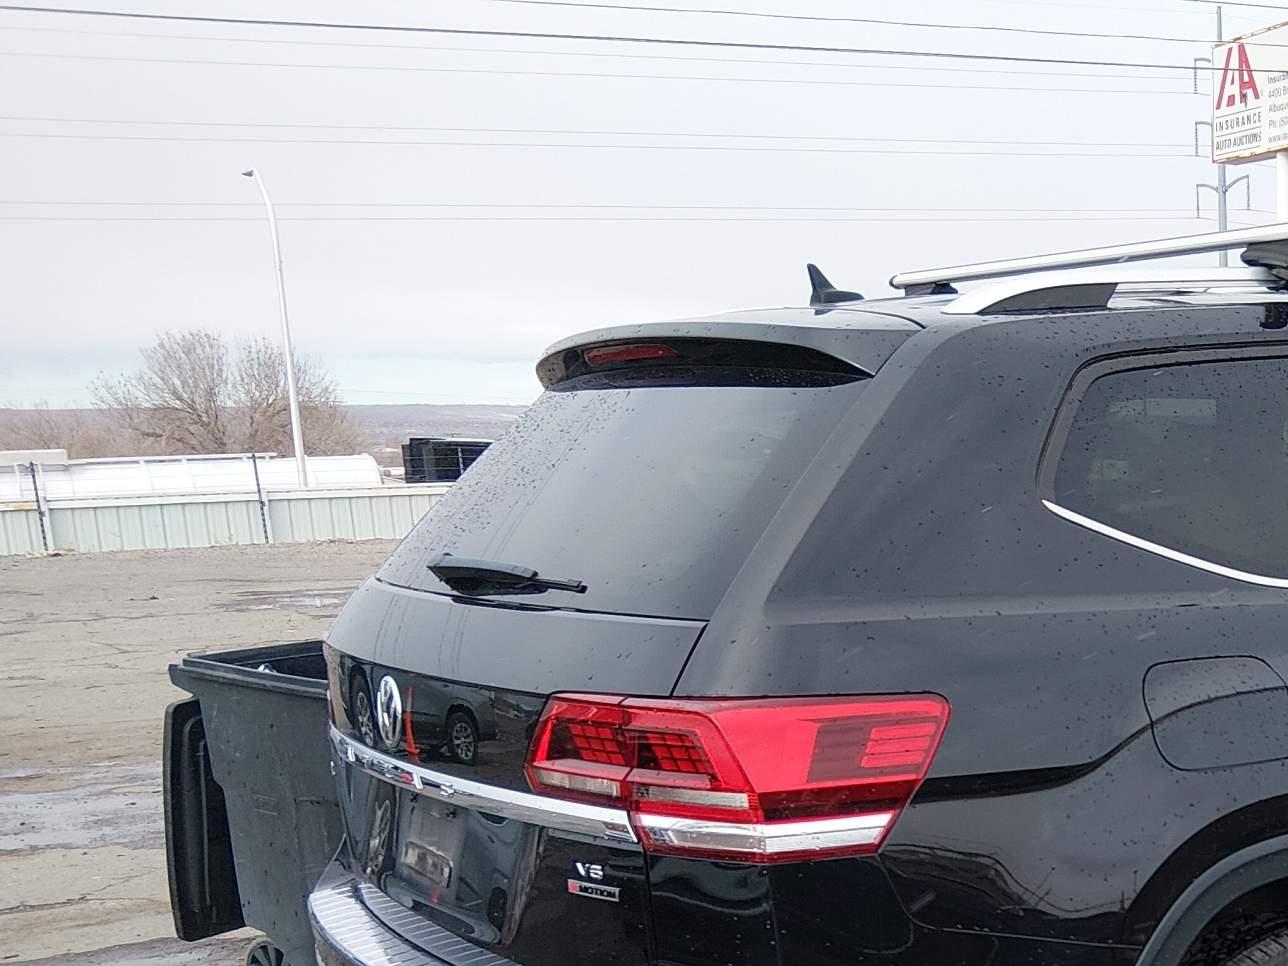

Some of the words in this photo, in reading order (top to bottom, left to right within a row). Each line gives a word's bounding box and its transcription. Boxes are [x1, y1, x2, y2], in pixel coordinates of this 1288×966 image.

[1215, 111, 1262, 132] INSURANCE
[1215, 138, 1232, 152] AUTO
[1232, 130, 1262, 148] AUCTIONS
